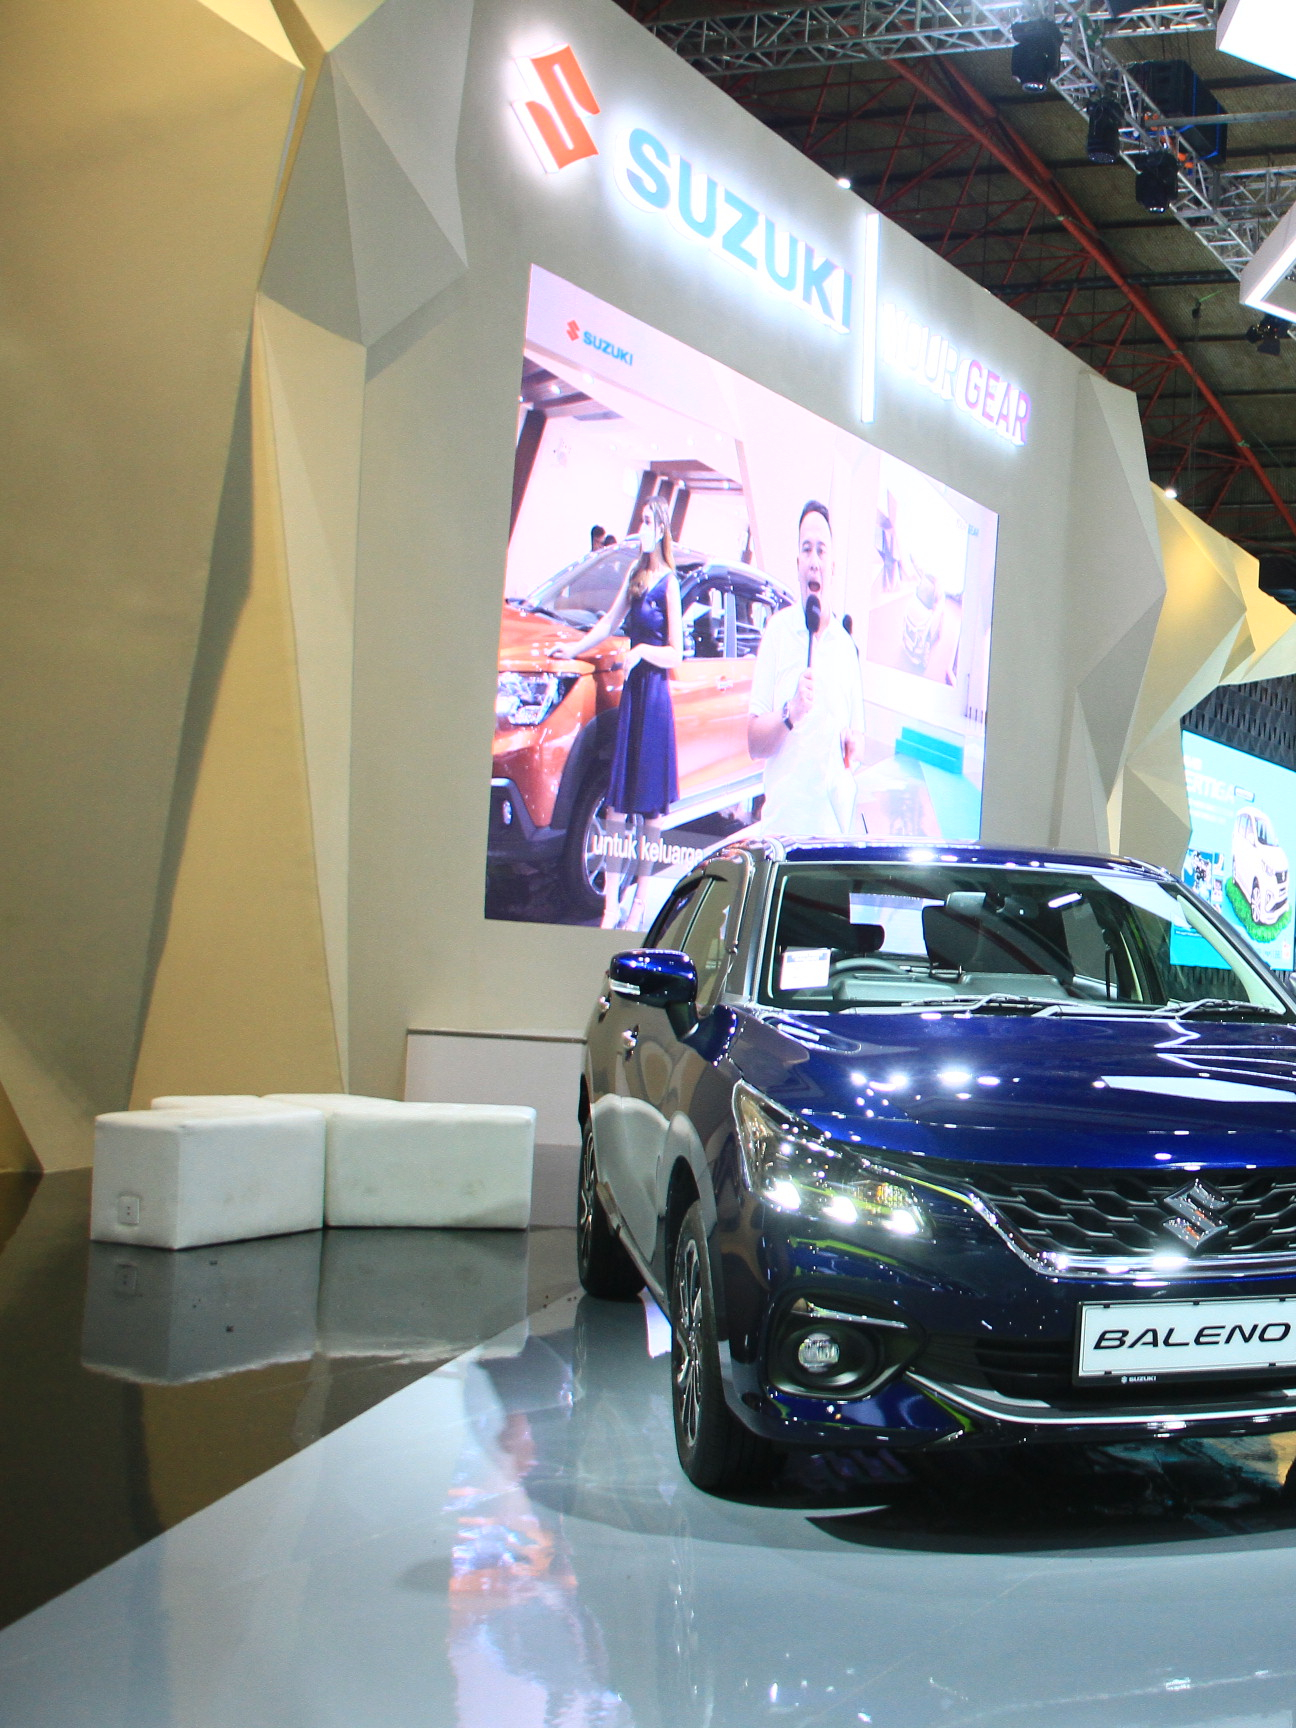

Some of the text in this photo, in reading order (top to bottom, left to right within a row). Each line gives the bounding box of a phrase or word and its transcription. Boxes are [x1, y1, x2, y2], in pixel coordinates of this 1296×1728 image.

[620, 127, 854, 333] SUZUKI
[583, 331, 634, 366] SUZUKI
[957, 359, 1032, 446] GEAR
[592, 833, 638, 860] untuk
[1093, 1322, 1291, 1350] BALENO
[1129, 1375, 1157, 1383] SUZUKI
